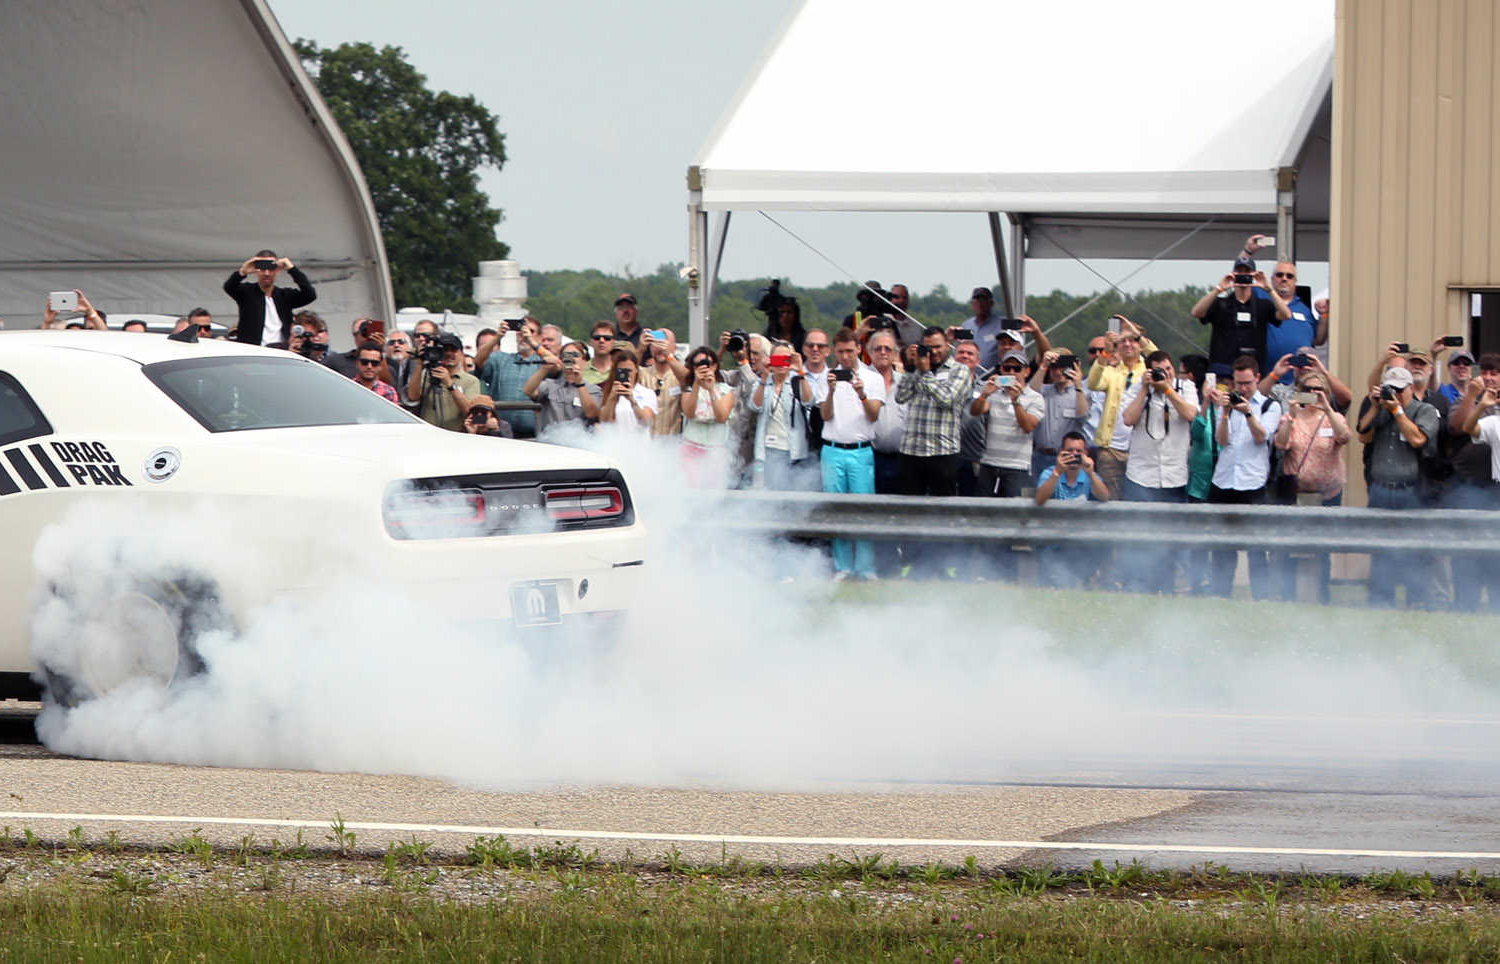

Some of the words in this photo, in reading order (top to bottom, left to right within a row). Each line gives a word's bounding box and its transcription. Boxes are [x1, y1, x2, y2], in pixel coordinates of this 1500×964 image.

[50, 441, 116, 463] DRAG
[66, 464, 134, 486] PAK
[490, 503, 540, 511] DODGE
